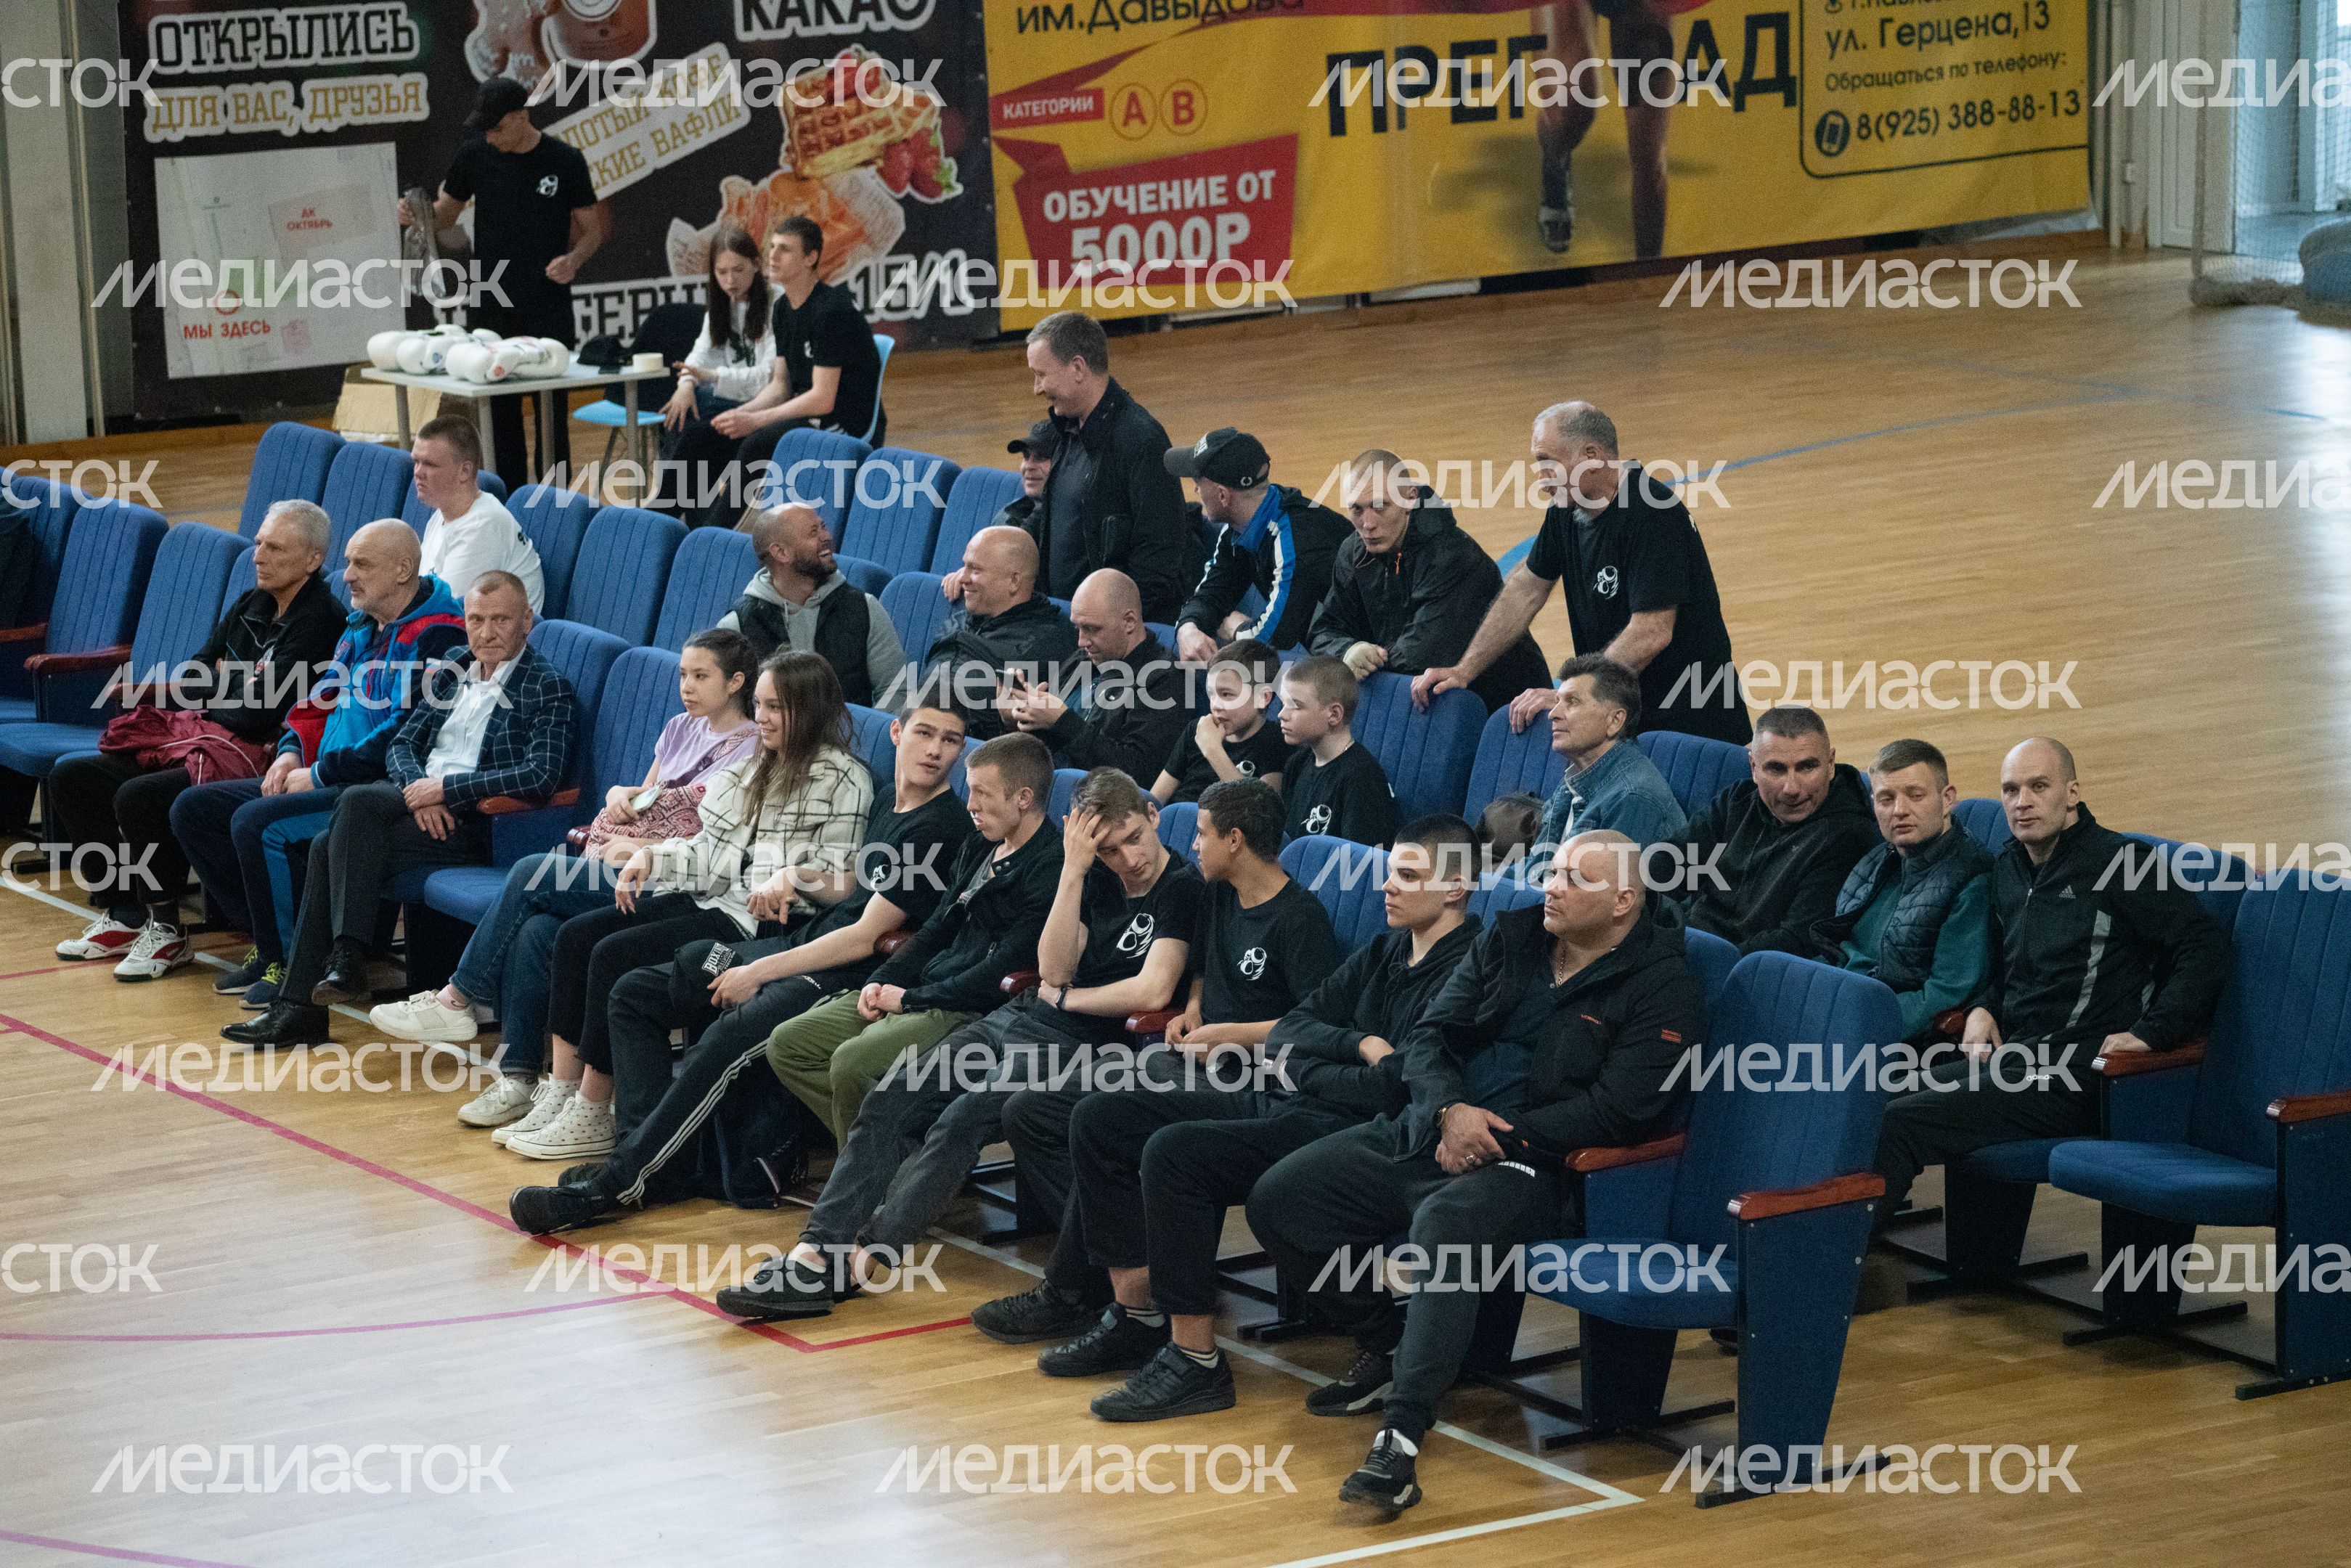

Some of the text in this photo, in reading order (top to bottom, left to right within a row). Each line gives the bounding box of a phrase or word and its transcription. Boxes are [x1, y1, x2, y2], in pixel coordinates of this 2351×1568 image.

[155, 9, 416, 68] ОТКРЫЛИСЬ
[1825, 51, 2067, 93] Обращаться по телефону:
[151, 81, 422, 134] ДЛЯ ВАС, ДРУЗЬЯ
[553, 87, 650, 151] ЛОТЫЙ
[650, 93, 742, 158] ВАФЛИ
[1003, 95, 1095, 121] КАТЕГОРИИ
[1857, 89, 2081, 143] 8(925) 388-88-13
[1043, 169, 1277, 223] ОБУЧЕНИЕ ОТ
[183, 319, 272, 340] МЫ ЗДЕСЬ
